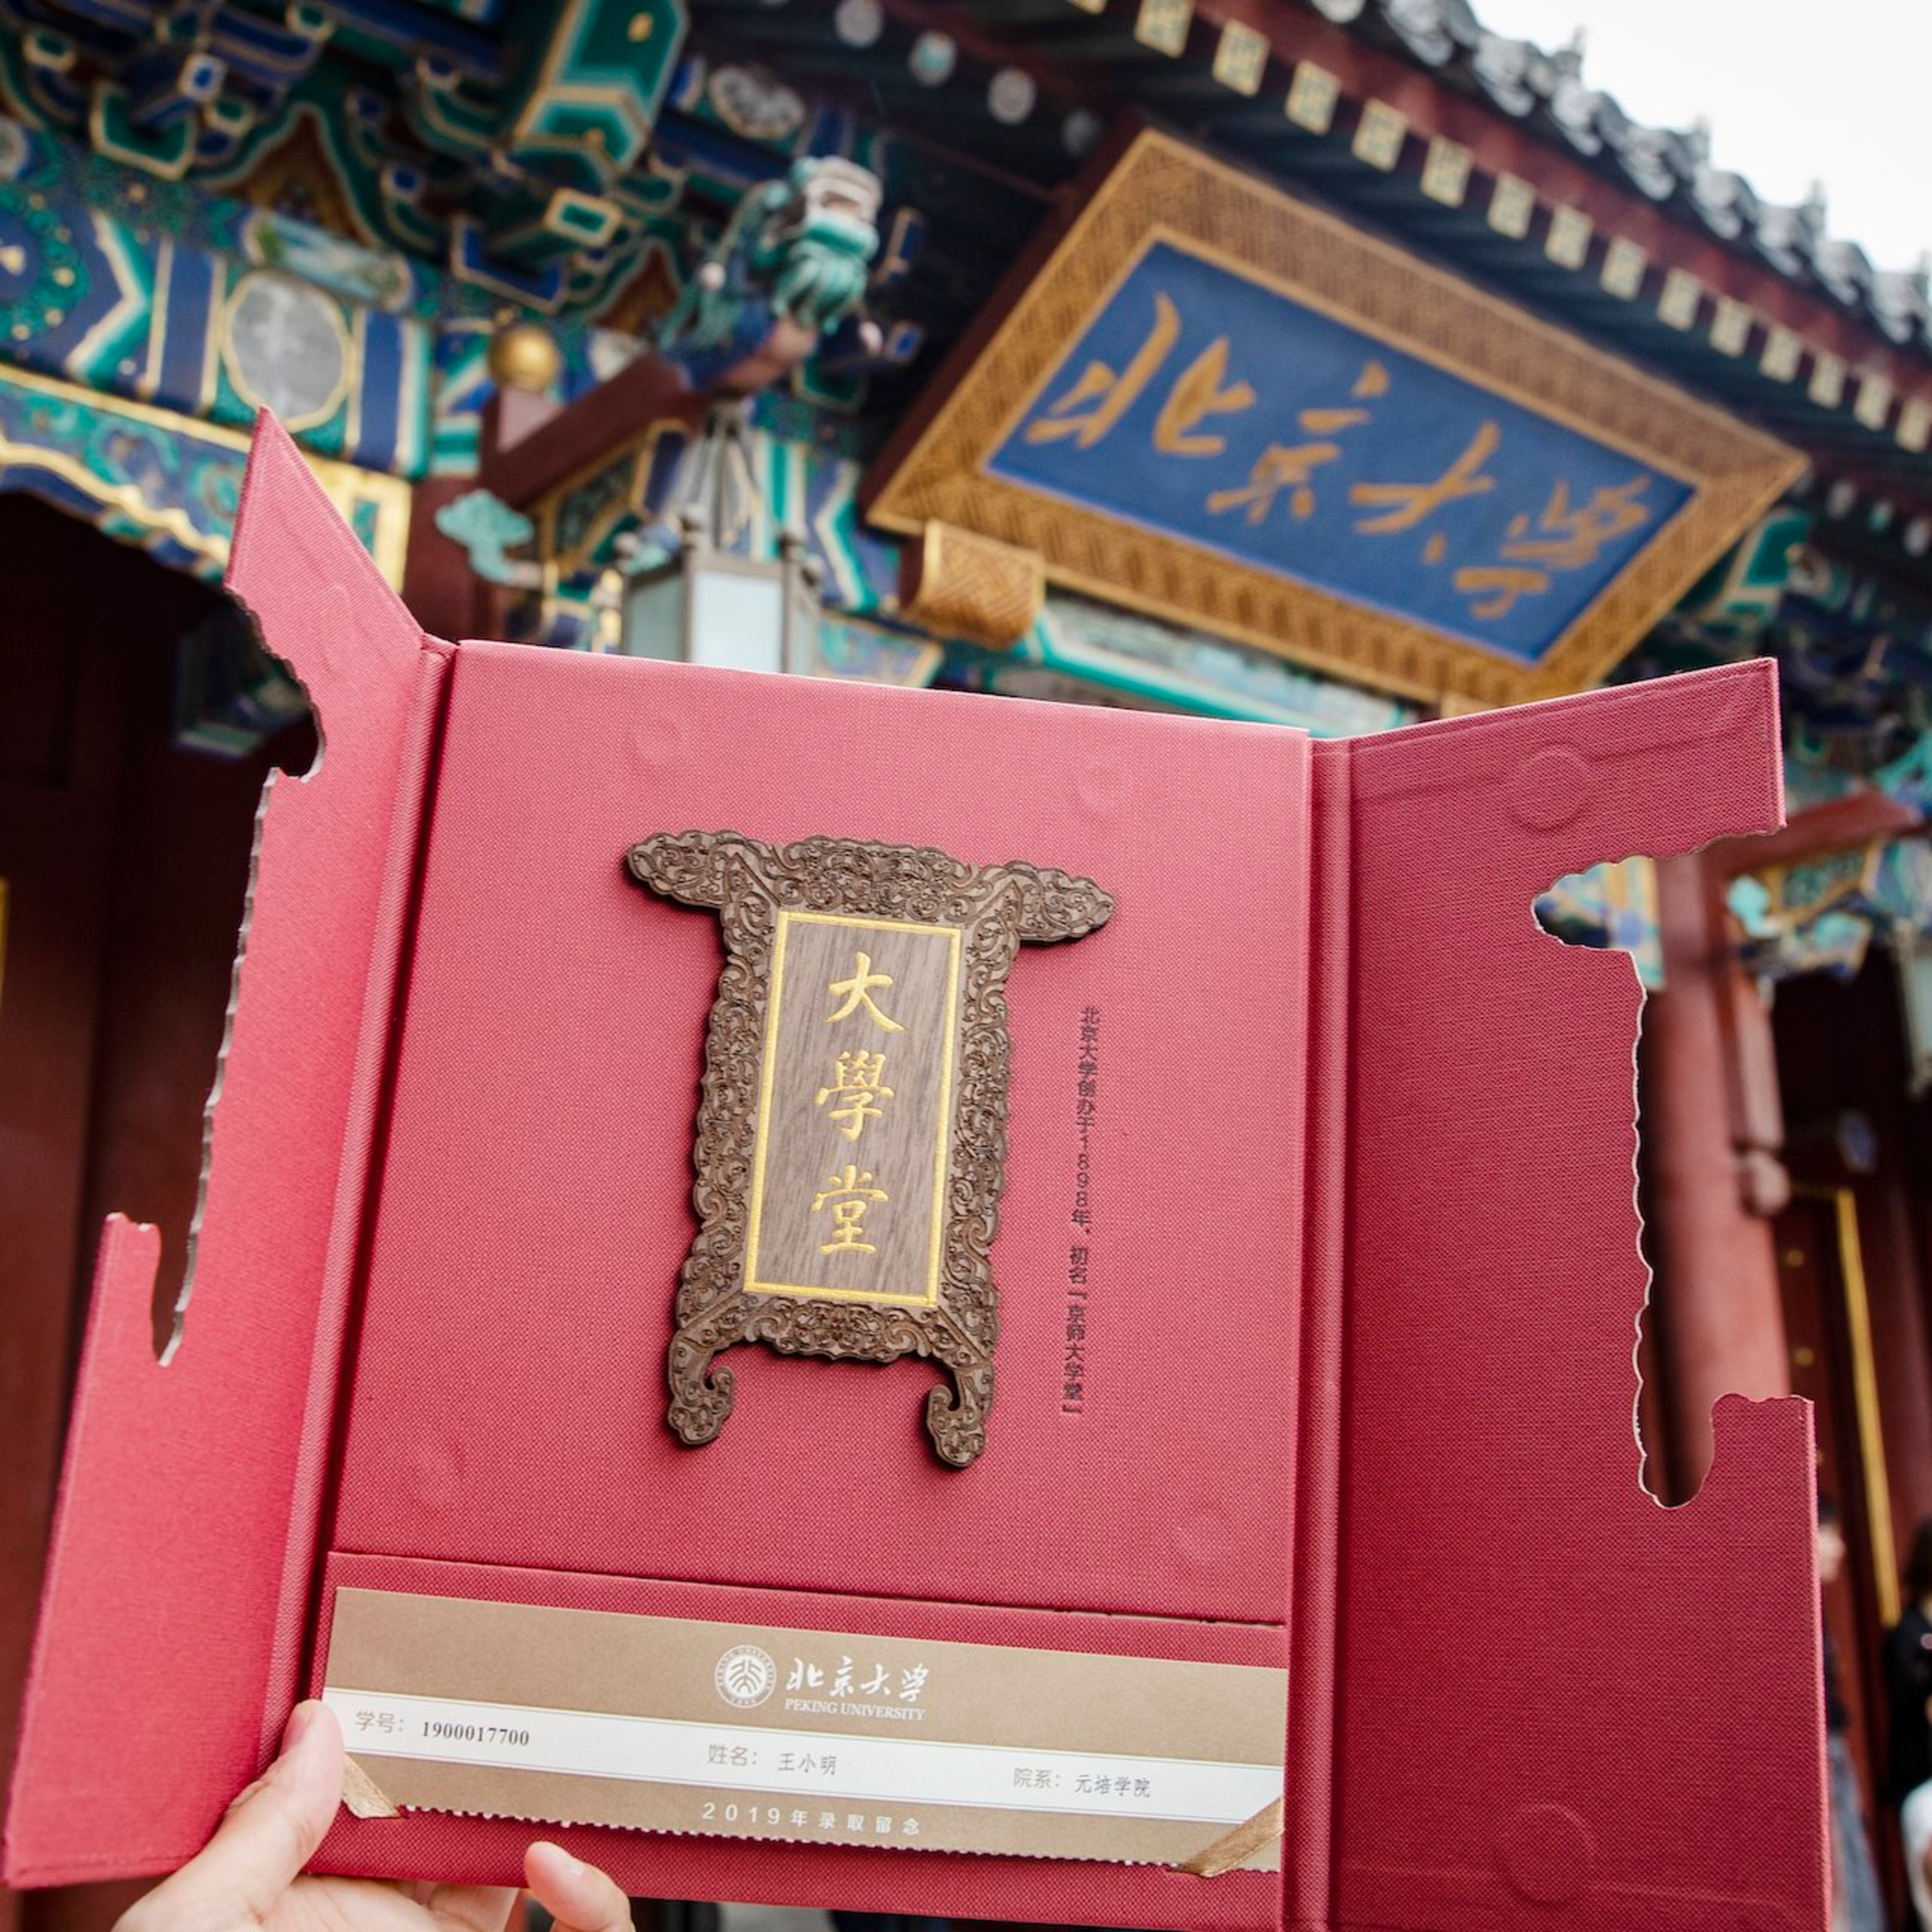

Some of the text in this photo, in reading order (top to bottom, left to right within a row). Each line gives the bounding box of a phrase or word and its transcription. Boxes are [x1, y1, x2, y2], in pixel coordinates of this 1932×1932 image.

[1024, 292, 1651, 620] 北京大学
[811, 951, 905, 1255] 大學堂
[785, 1656, 929, 1703] 北京大学
[784, 1698, 926, 1721] PEKING UNIVERSITY
[422, 1721, 530, 1747] 1900017700
[777, 1752, 837, 1776] 王小明
[1074, 1774, 1151, 1797] 元培学院
[701, 1802, 921, 1835] 2019年录取留念
